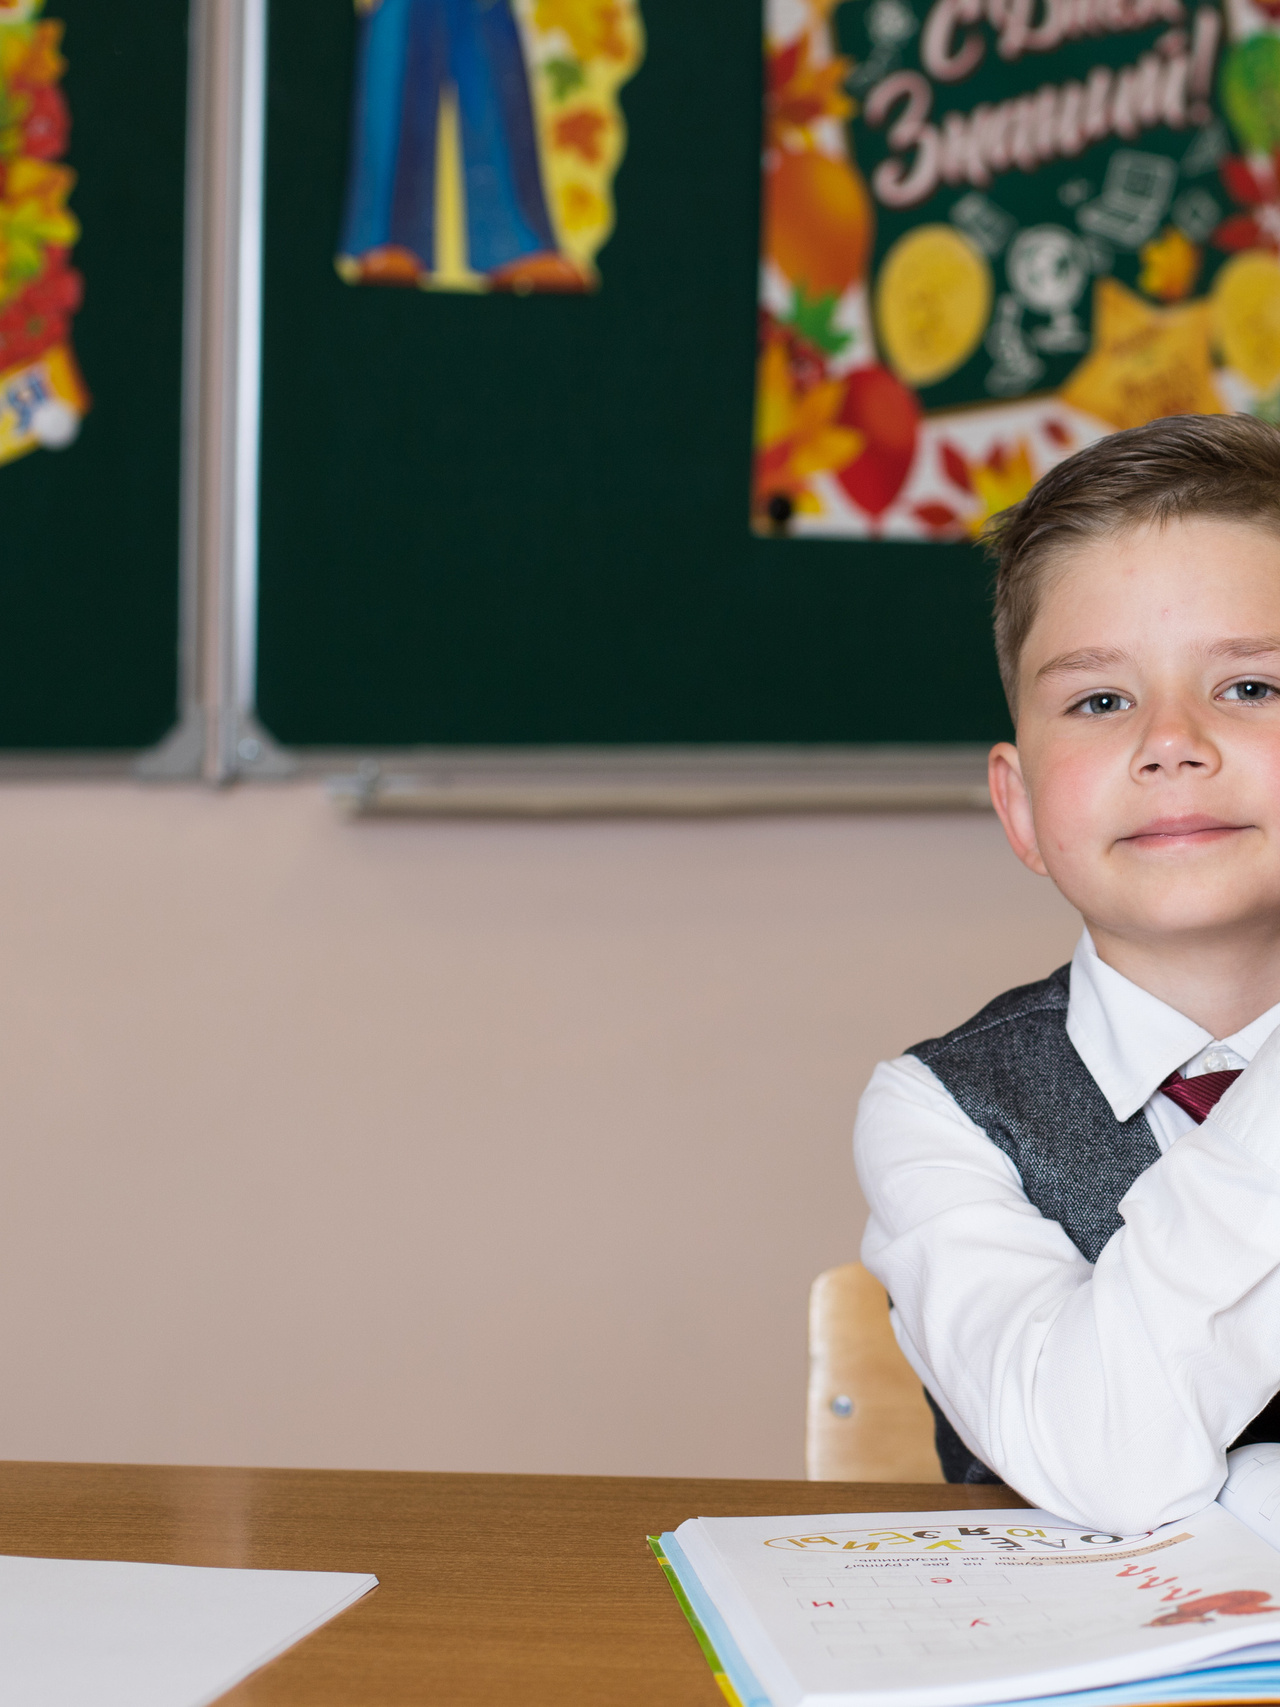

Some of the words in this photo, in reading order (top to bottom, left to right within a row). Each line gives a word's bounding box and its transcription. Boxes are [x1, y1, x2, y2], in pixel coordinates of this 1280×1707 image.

[912, 1530, 942, 1539] Э
[957, 1527, 991, 1536] Я
[1006, 1528, 1047, 1538] Ю
[787, 1535, 839, 1548] Ы
[867, 1531, 916, 1545] Е
[981, 1536, 1026, 1551] Ё
[1027, 1538, 1067, 1549] А
[842, 1540, 880, 1551] И
[923, 1539, 965, 1551] У
[844, 1562, 910, 1570] группы?
